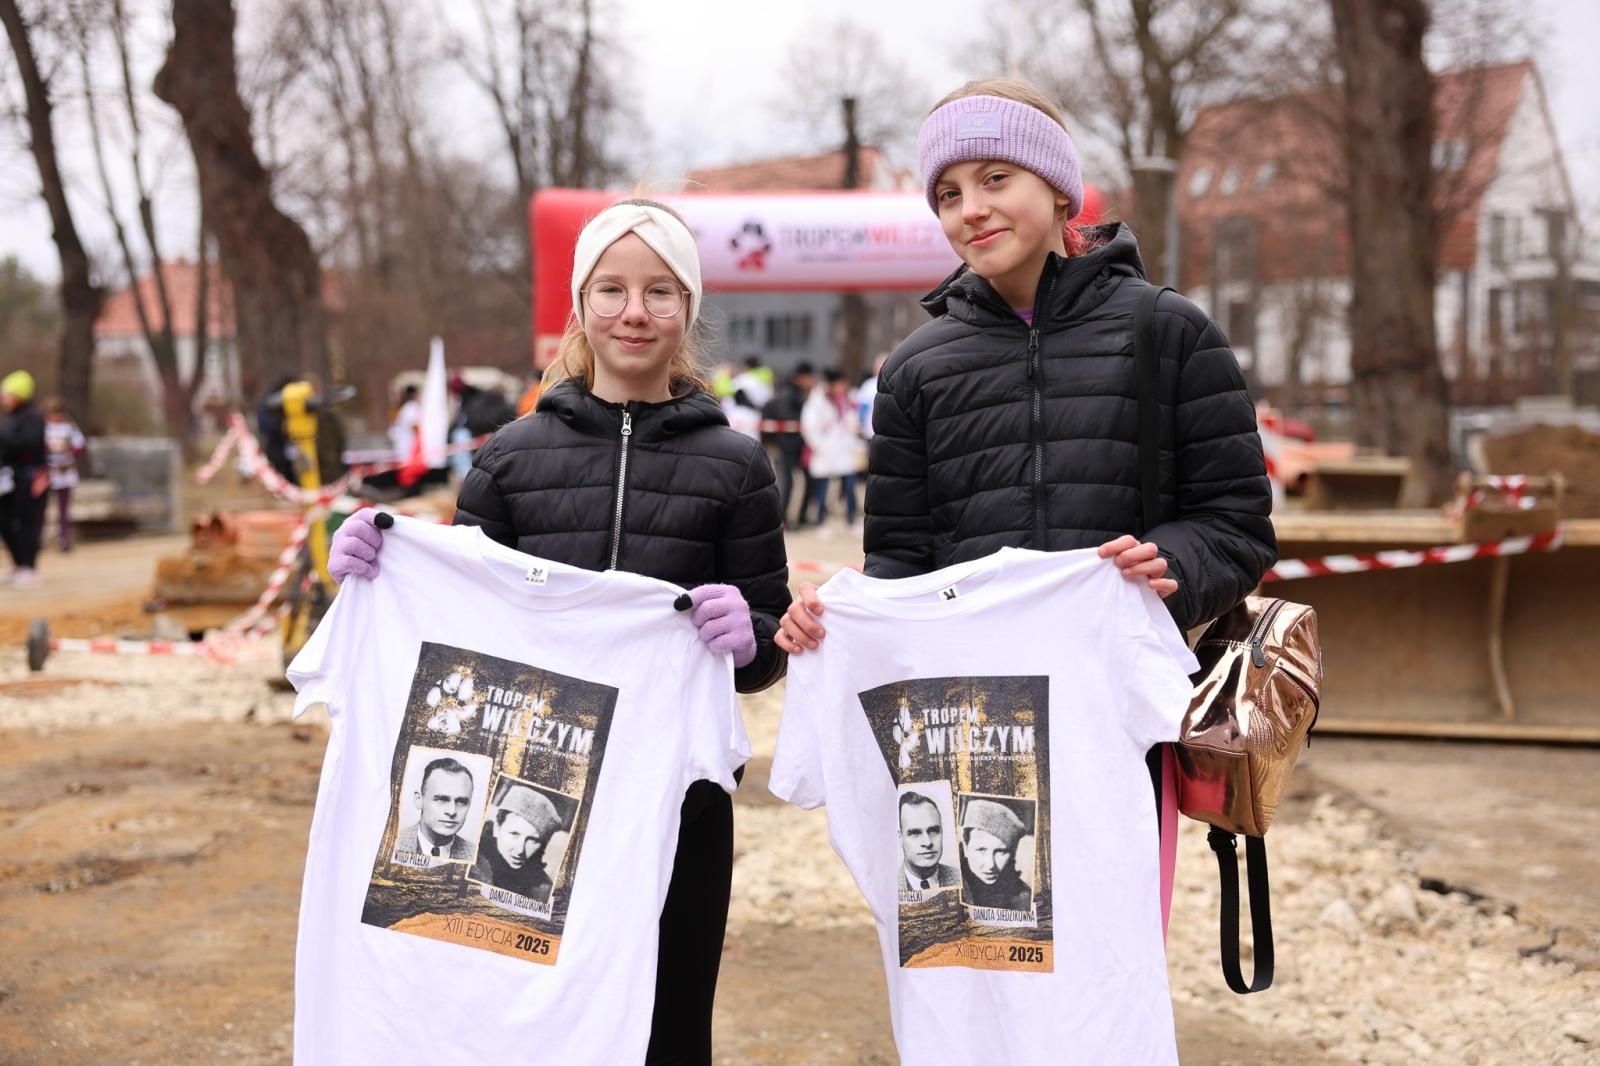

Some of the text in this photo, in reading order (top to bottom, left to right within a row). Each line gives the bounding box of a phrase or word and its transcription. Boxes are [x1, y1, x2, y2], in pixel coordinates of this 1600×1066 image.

[487, 685, 545, 712] TROPEM
[922, 706, 978, 726] TROPEM
[482, 703, 595, 753] WILCZYM
[925, 725, 1036, 754] WILCZYM
[489, 889, 513, 905] DANUTA
[974, 908, 996, 921] DANUTA
[443, 915, 551, 955] XIII EDYCJA 2025
[1009, 946, 1044, 963] 2025
